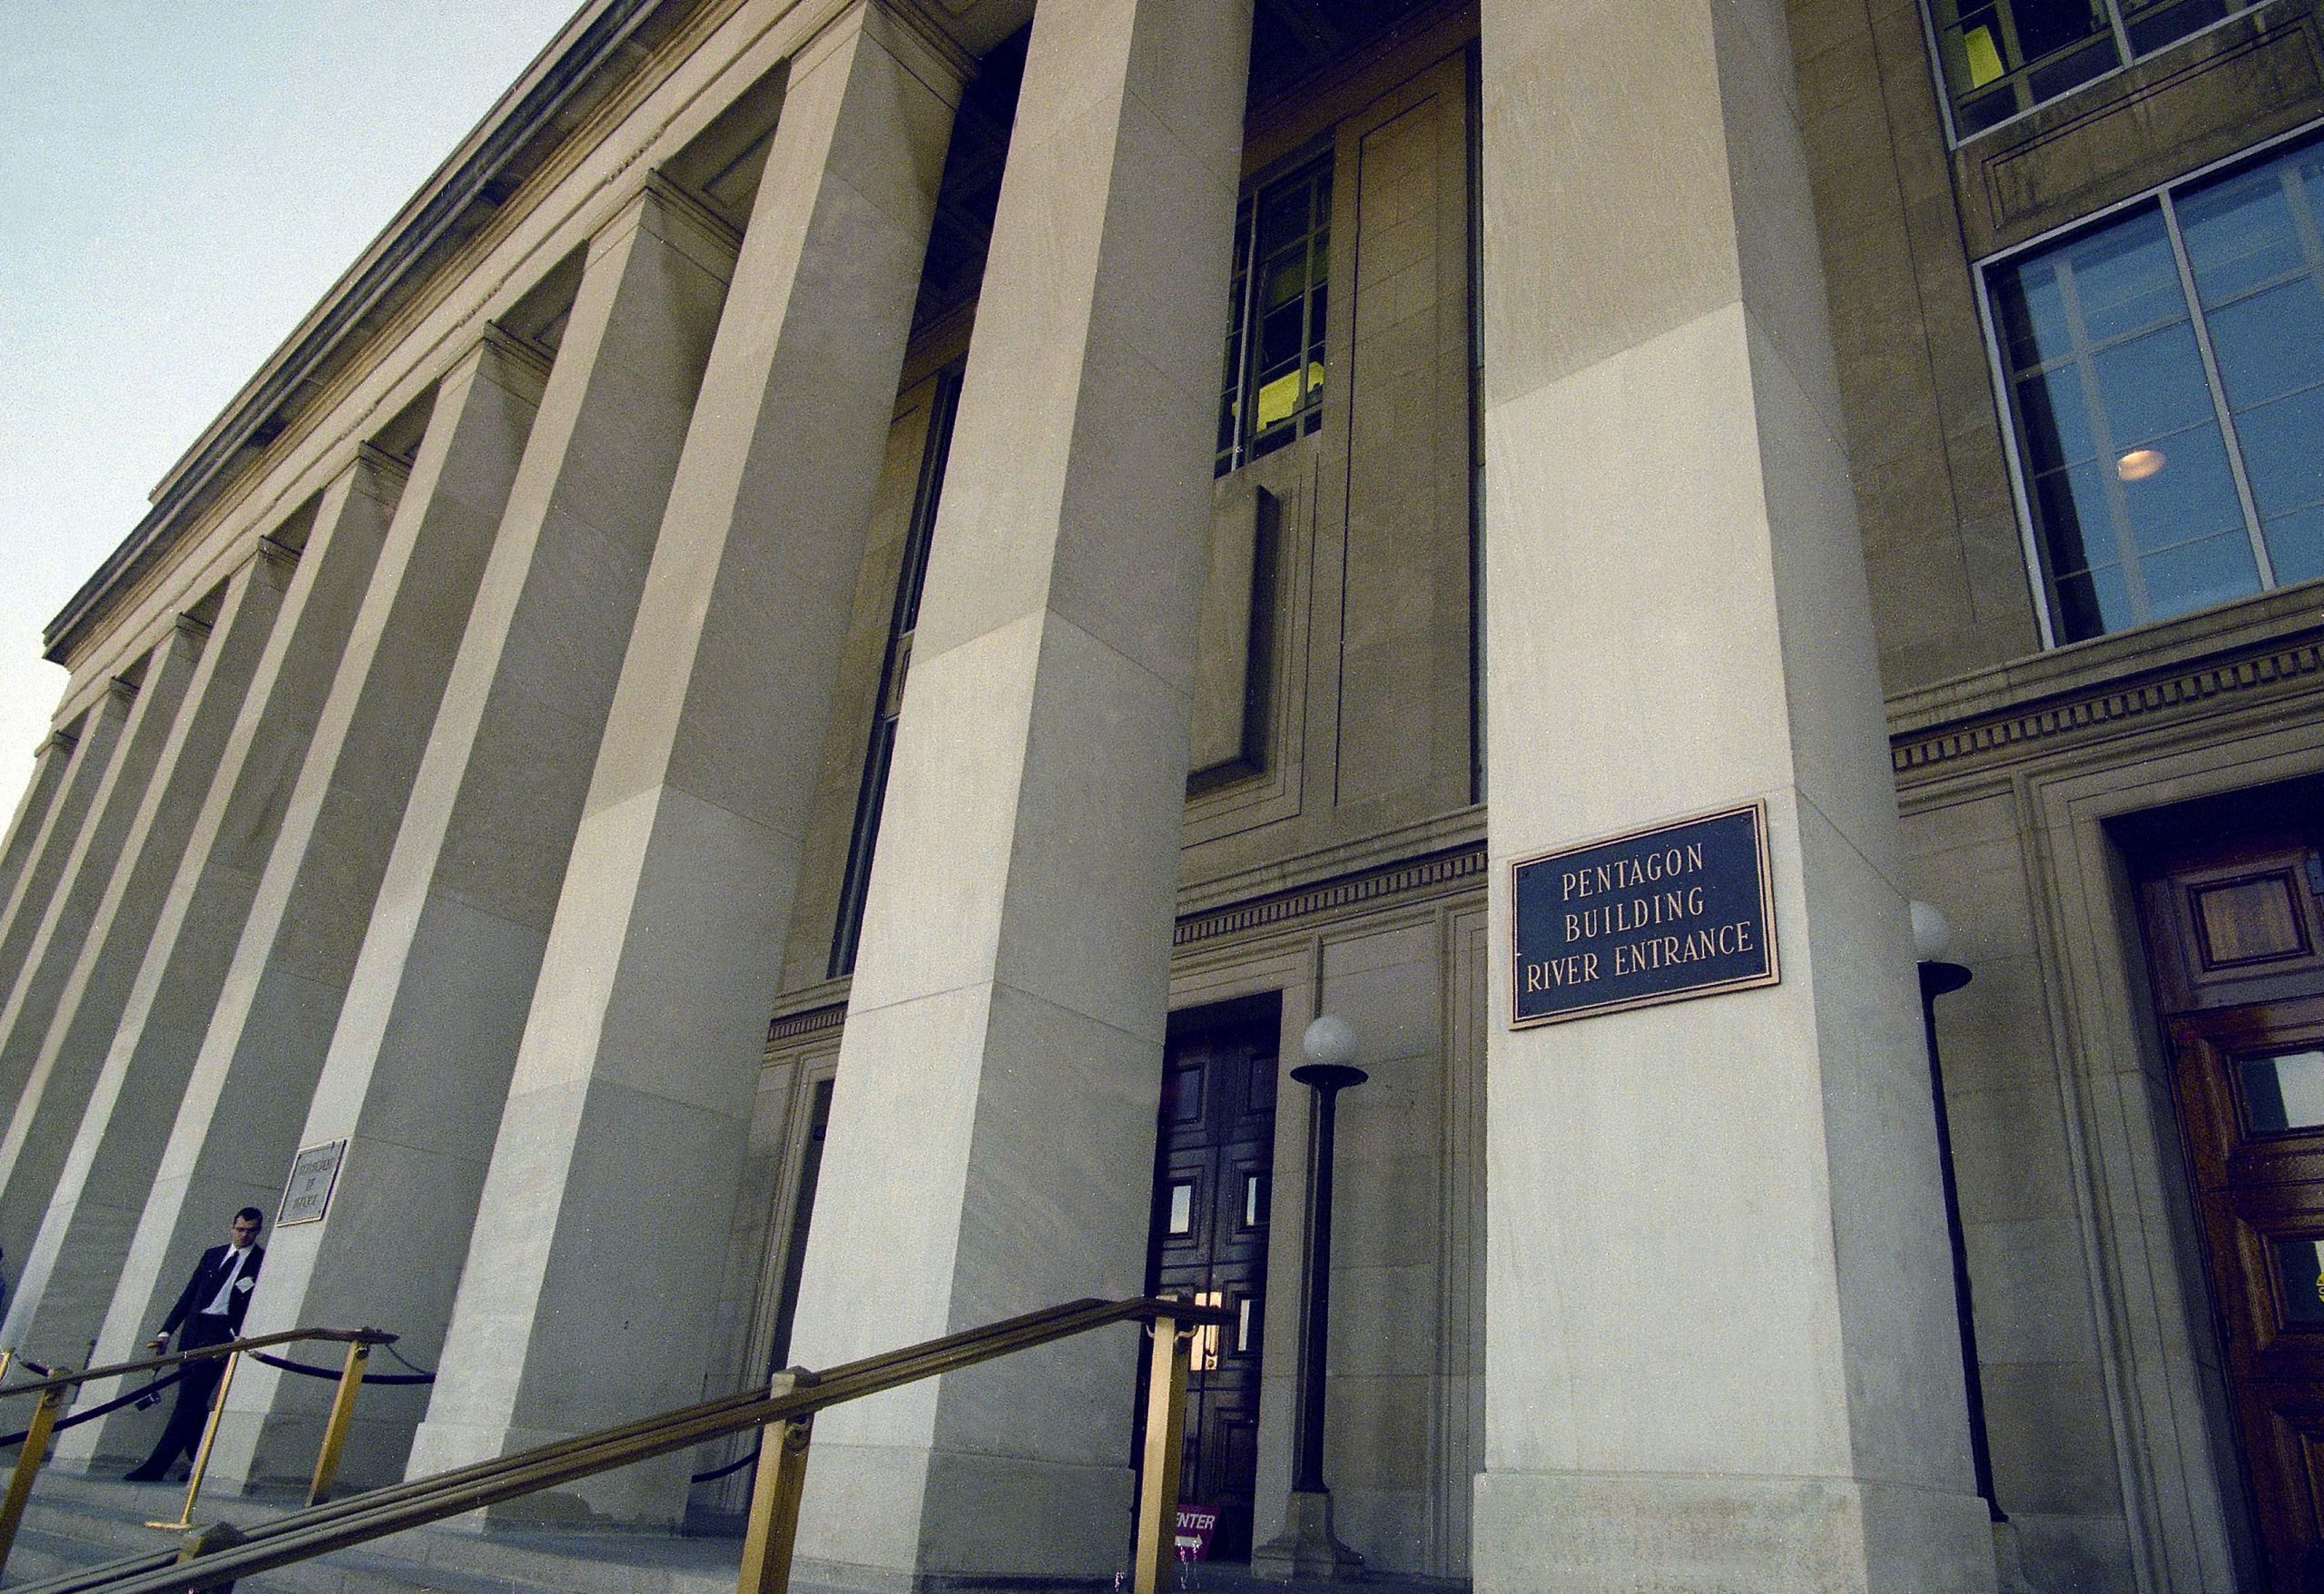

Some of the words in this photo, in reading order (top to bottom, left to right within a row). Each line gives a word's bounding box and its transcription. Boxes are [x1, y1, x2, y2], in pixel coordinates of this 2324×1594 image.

[1561, 842, 1703, 900] PENTAGON
[1565, 887, 1703, 943] BUILDING
[1526, 953, 1600, 993] RIVER
[1614, 921, 1754, 977] ENTRANCE
